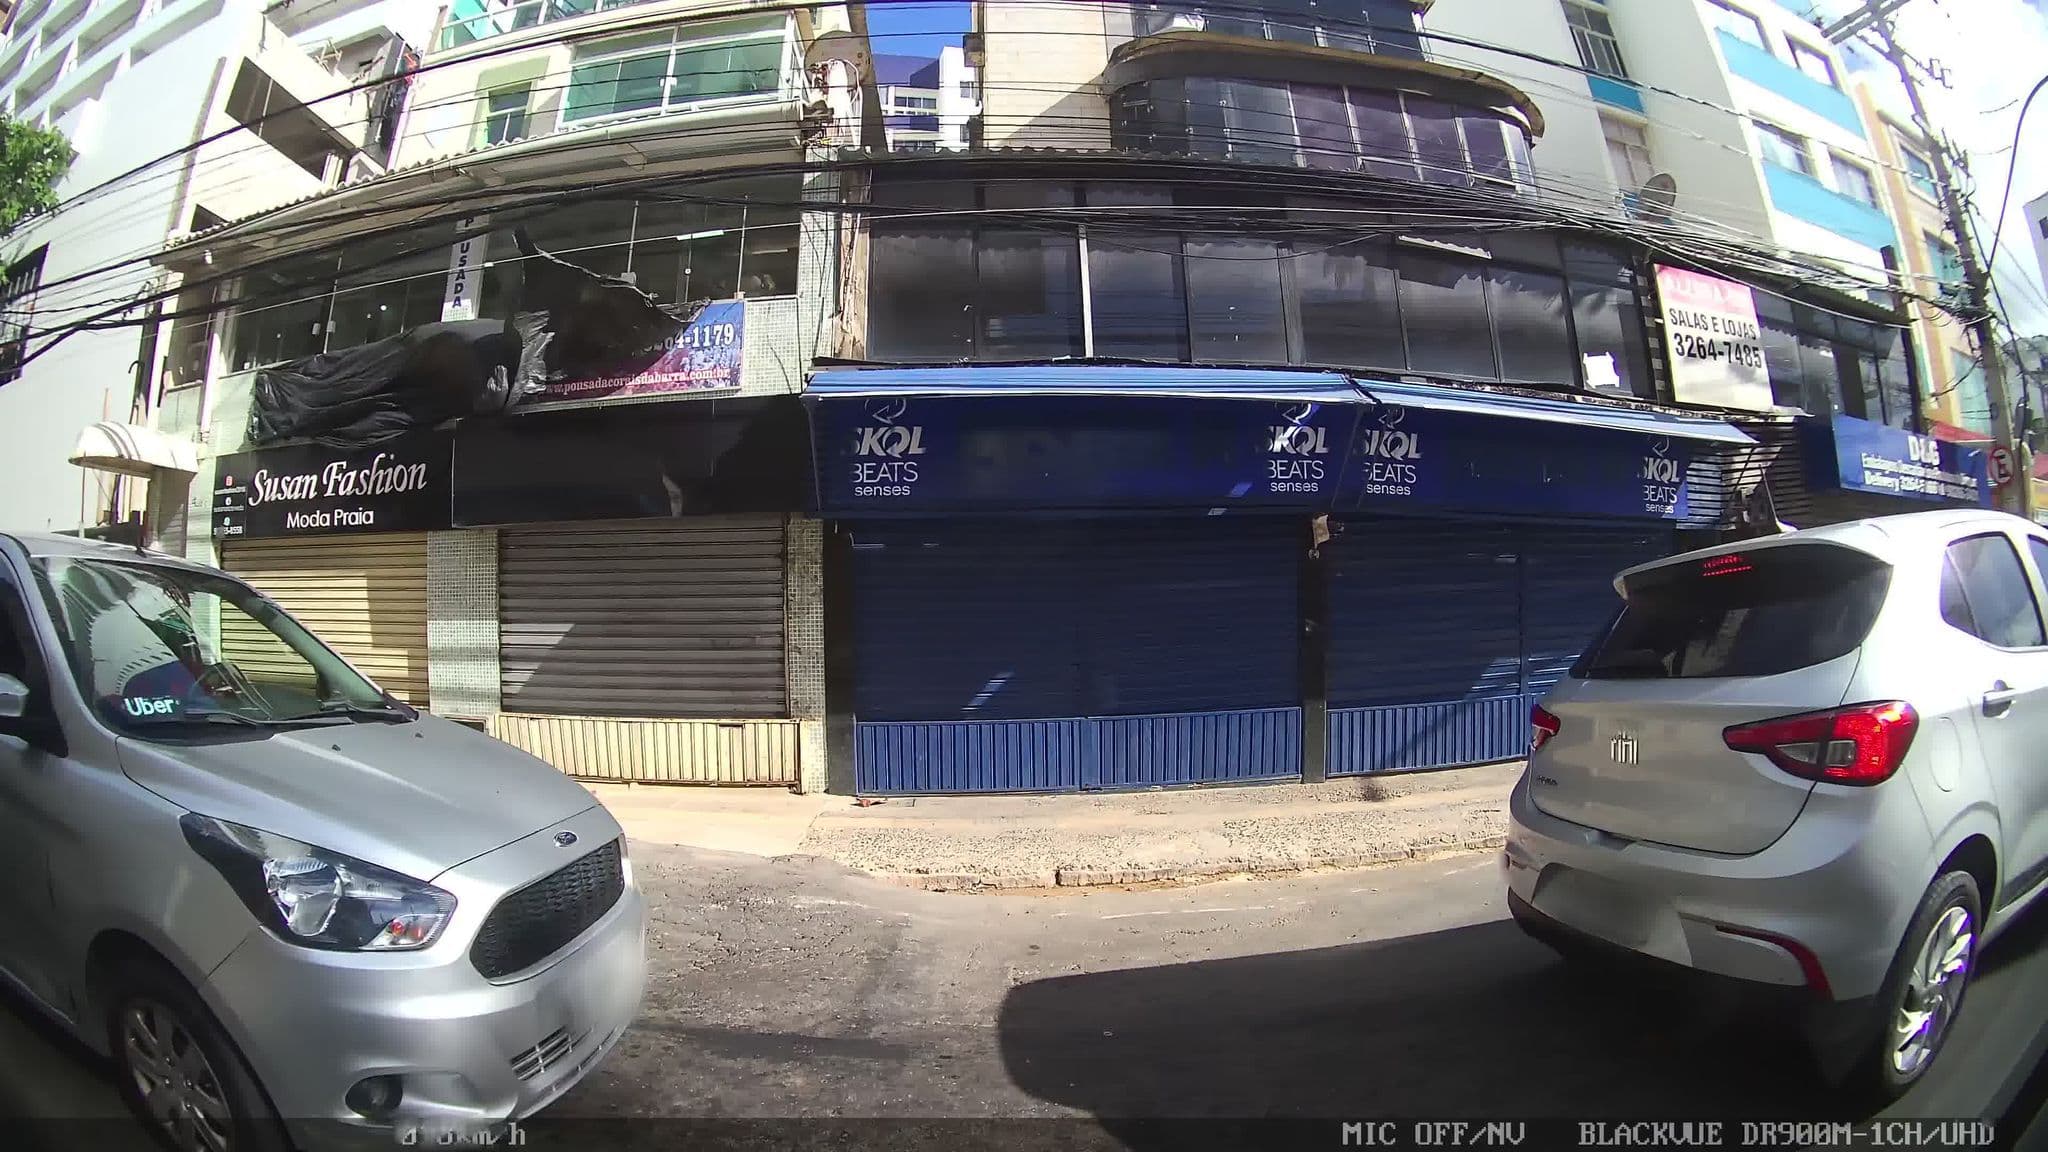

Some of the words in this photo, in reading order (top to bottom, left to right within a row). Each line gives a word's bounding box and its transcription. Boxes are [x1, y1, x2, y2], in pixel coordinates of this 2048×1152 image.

[452, 217, 474, 308] PUSADA
[1669, 308, 1709, 331] SALAS
[1711, 313, 1719, 333] E
[1722, 318, 1757, 340] LOJAS
[1673, 333, 1762, 368] 3264-7485
[248, 469, 318, 506] Susan
[322, 453, 428, 498] Fashion
[1270, 481, 1319, 492] senses
[1366, 483, 1411, 495] senses
[854, 485, 911, 497] senses
[286, 510, 331, 529] Moda
[334, 507, 374, 526] Praia
[1646, 503, 1674, 514] senses
[124, 697, 174, 716] Uber
